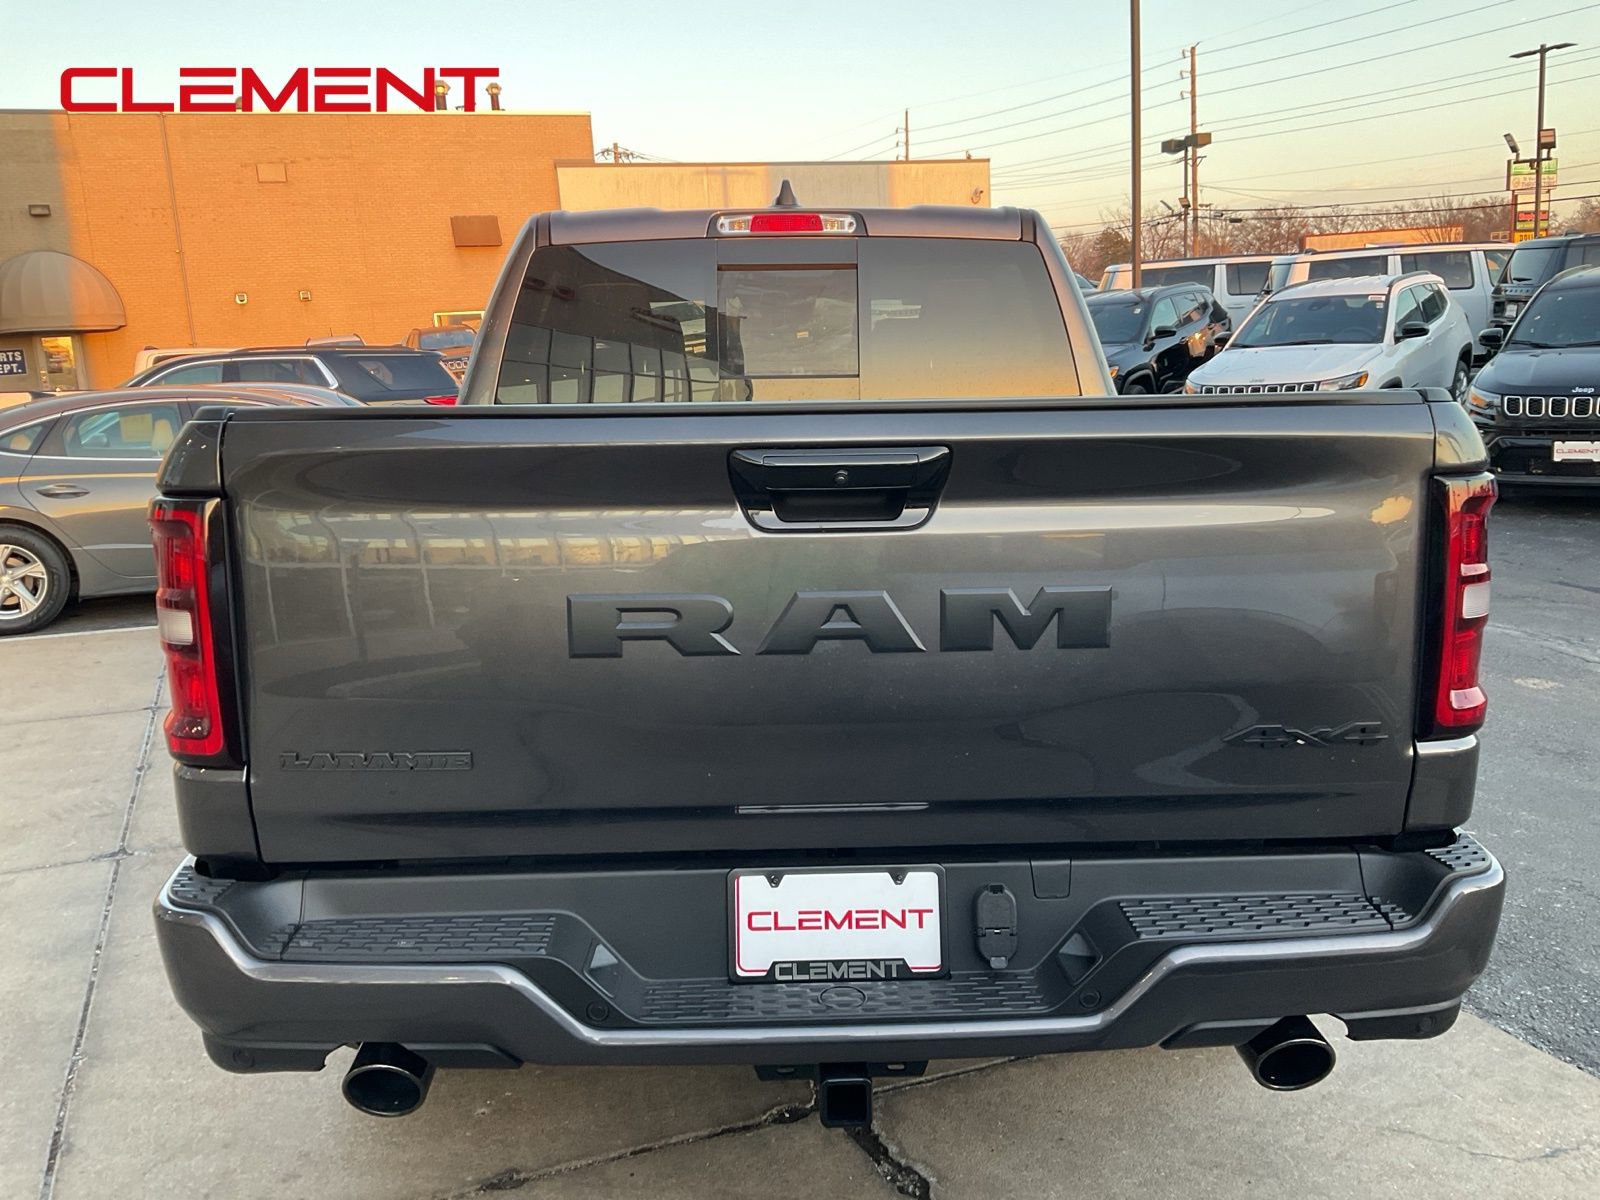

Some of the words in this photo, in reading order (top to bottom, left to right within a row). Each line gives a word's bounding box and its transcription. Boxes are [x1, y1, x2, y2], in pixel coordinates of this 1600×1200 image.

[1571, 386, 1595, 394] Jeep
[566, 585, 1113, 659] RAM
[747, 908, 934, 932] CLEMENT
[774, 959, 904, 982] CLEMENT
